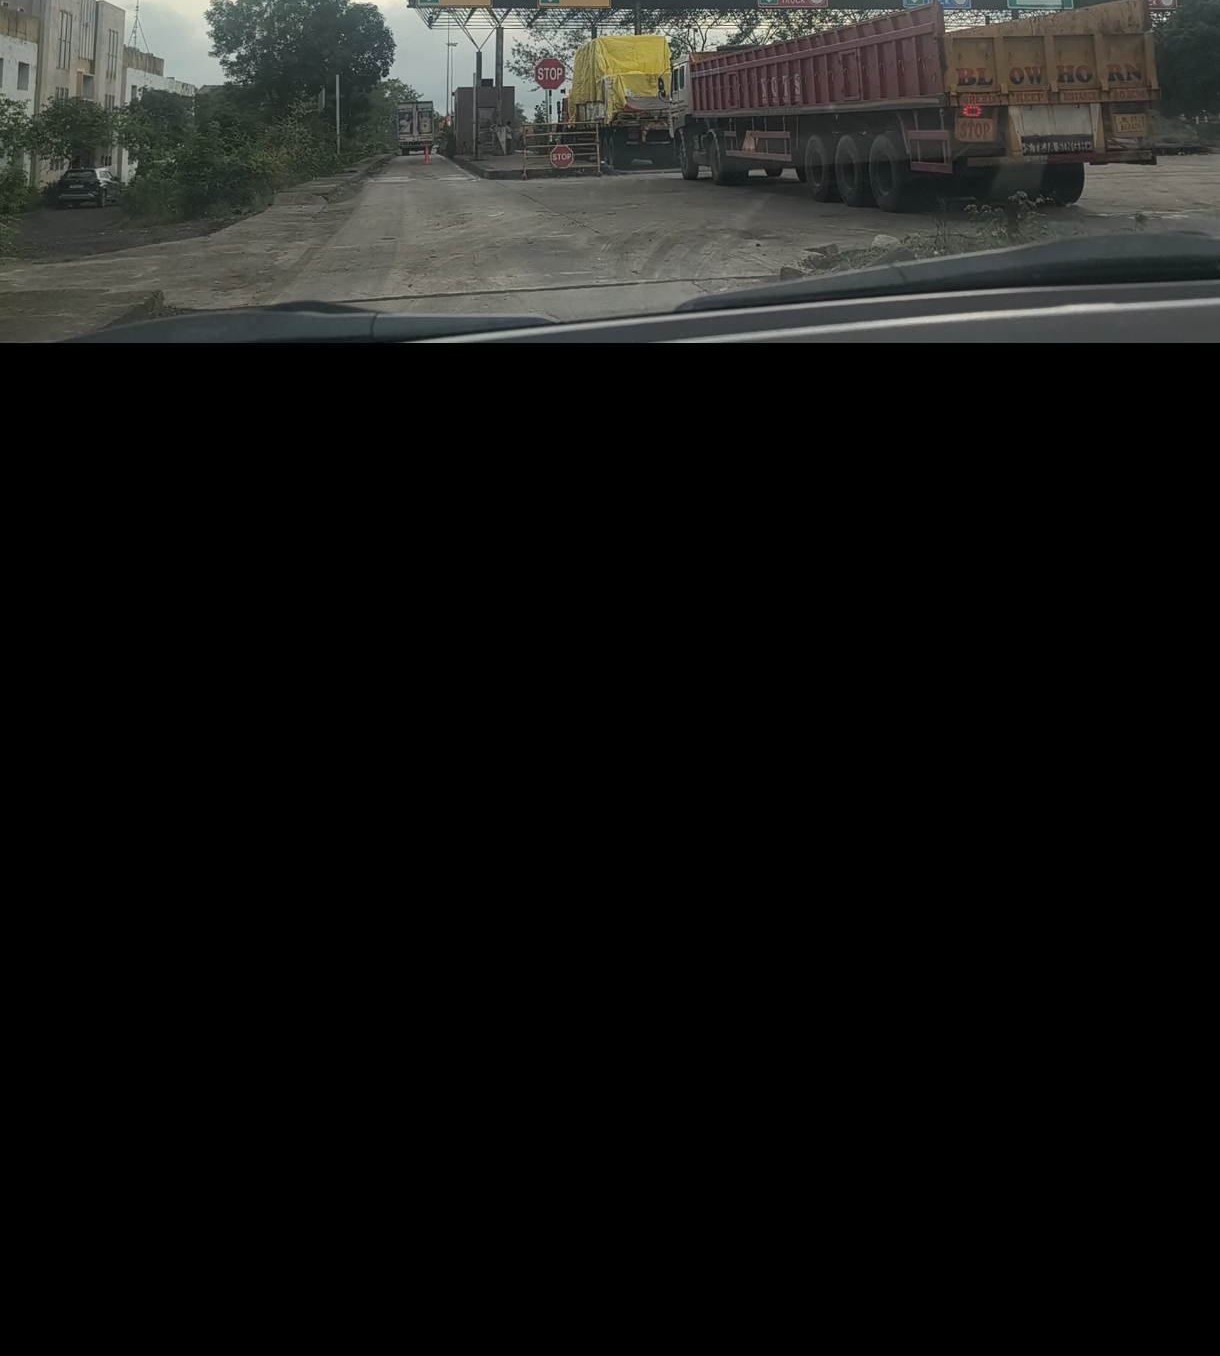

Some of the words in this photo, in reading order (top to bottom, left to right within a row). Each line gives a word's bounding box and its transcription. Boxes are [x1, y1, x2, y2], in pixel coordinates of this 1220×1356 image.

[537, 68, 563, 81] STOP
[960, 122, 990, 139] STOP
[552, 153, 572, 161] STOP
